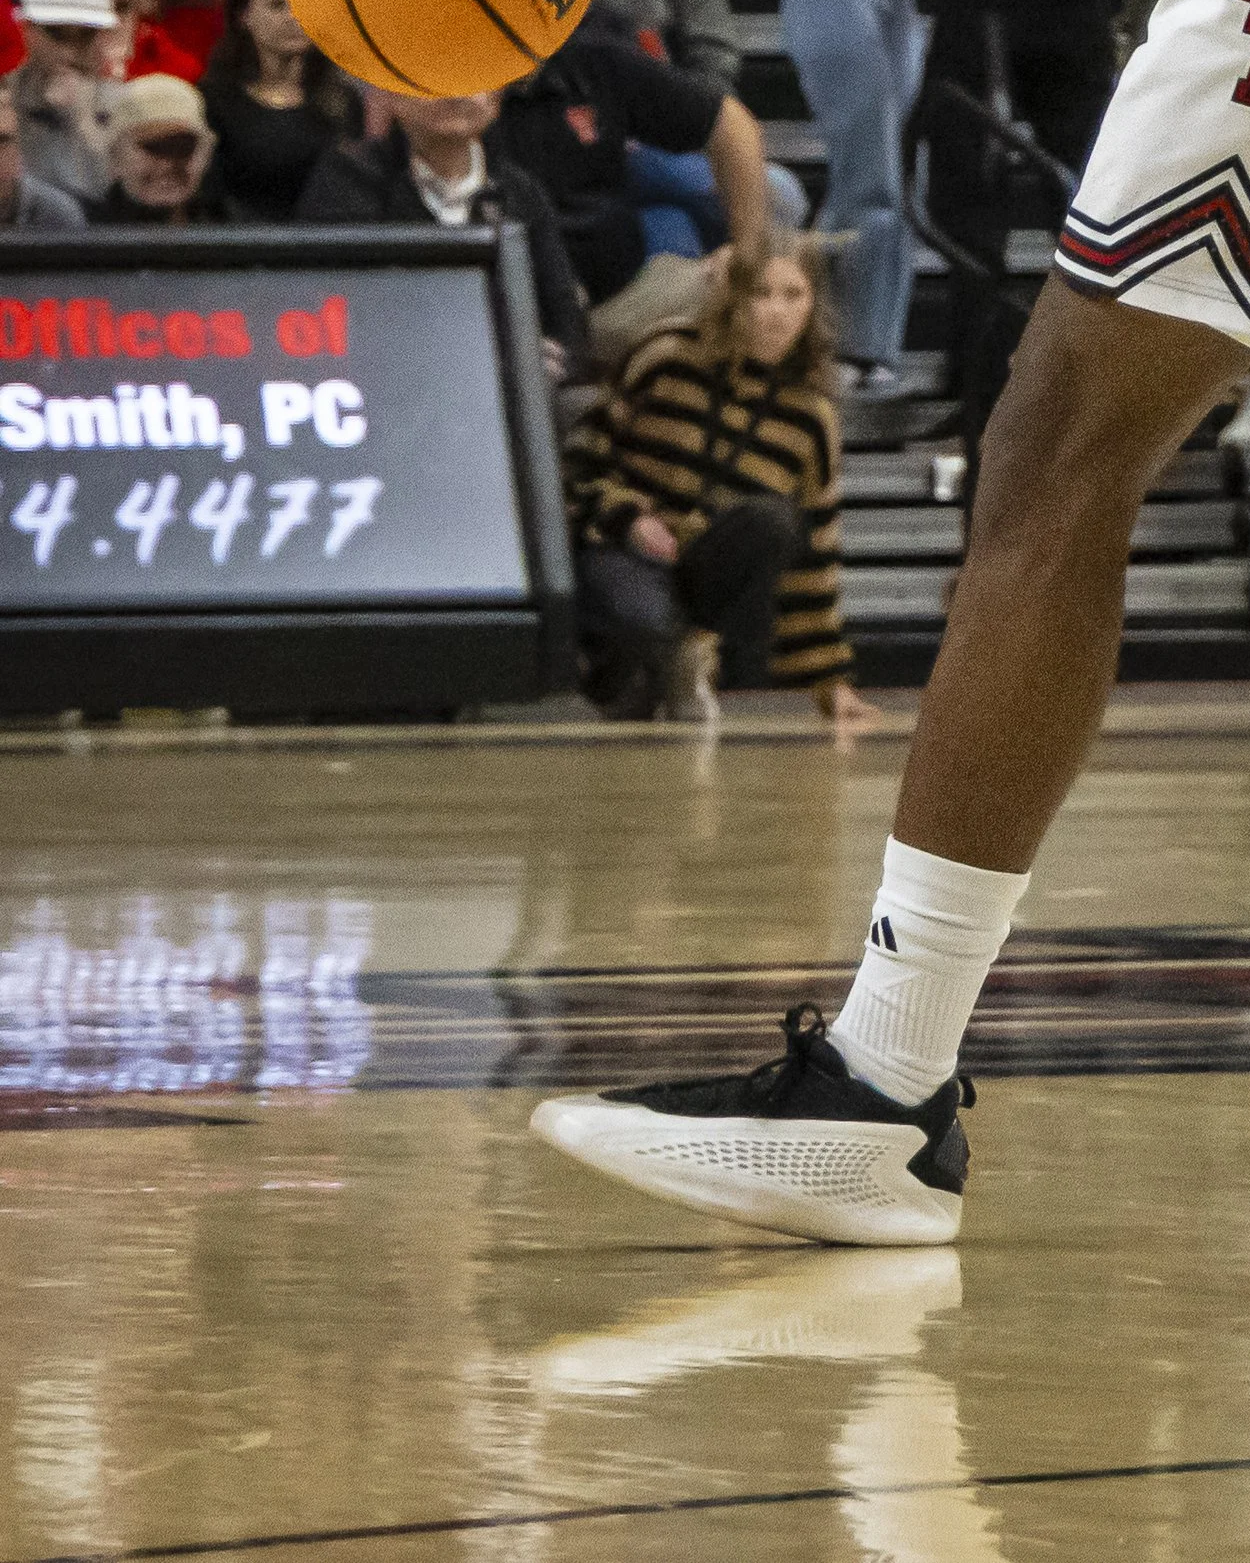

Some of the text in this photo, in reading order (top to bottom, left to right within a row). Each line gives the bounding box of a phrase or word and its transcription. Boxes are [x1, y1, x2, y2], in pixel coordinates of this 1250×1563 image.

[0, 295, 349, 360] Offices of
[0, 379, 367, 462] Smith, PC
[0, 472, 383, 567] 4.4477
